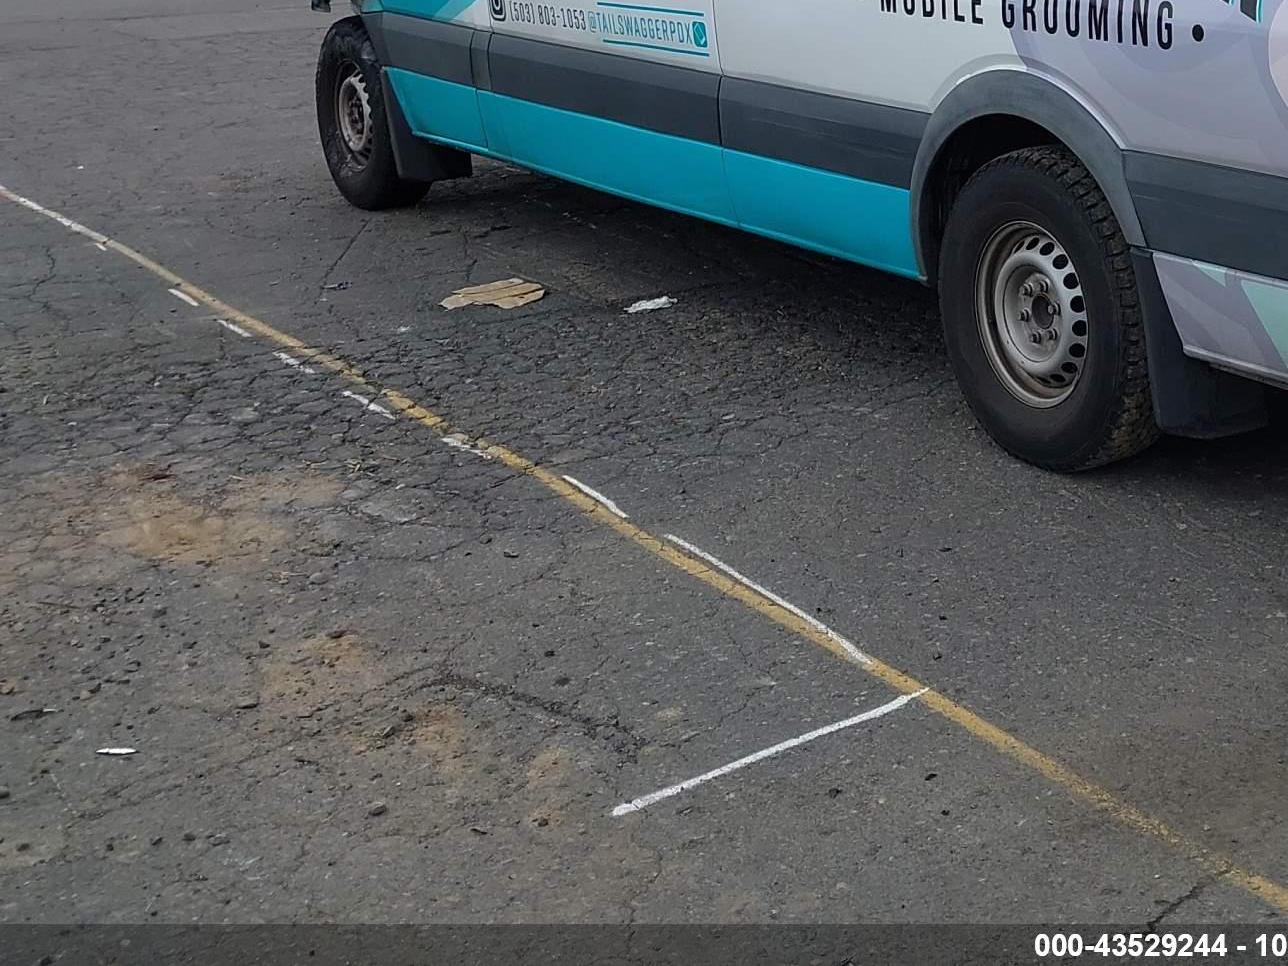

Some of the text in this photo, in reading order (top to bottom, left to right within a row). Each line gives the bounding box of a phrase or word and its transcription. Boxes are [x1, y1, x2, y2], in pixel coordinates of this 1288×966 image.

[509, 0, 693, 45] (503) 803-1053 @TAILSWAGGERPDX
